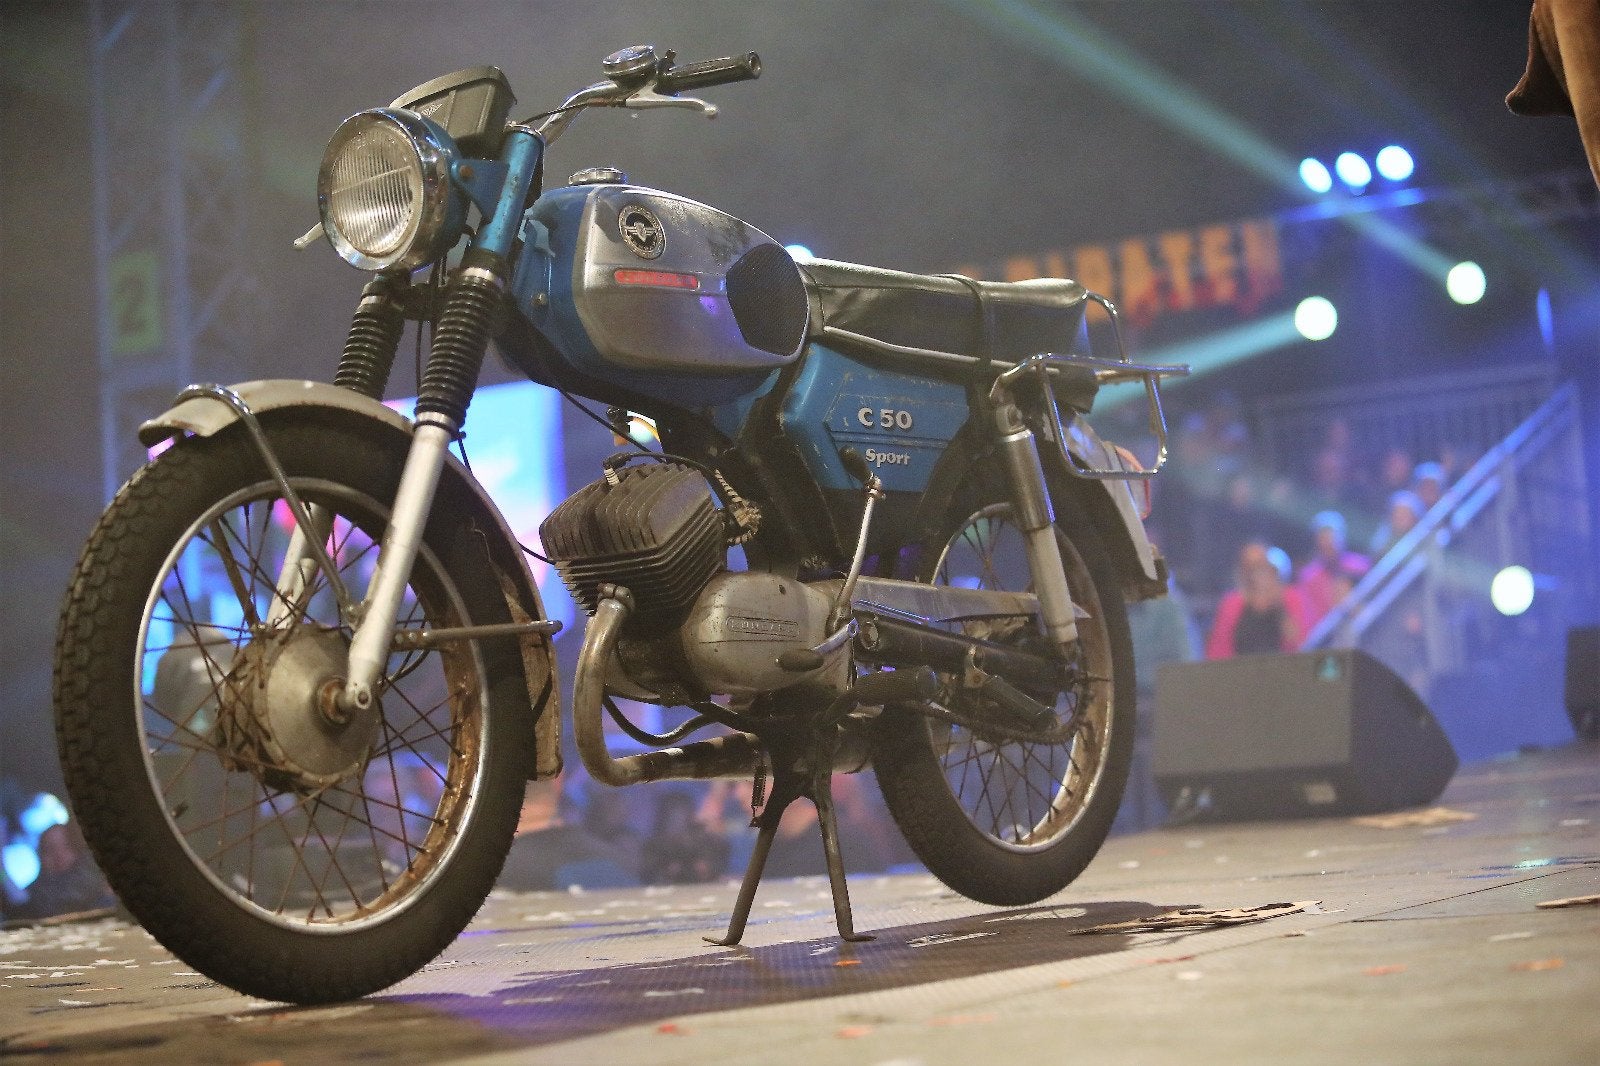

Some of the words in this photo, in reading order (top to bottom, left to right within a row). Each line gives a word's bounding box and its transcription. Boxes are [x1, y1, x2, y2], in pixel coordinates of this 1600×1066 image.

[857, 407, 874, 428] C
[880, 408, 913, 430] 50
[865, 448, 911, 468] Sport
